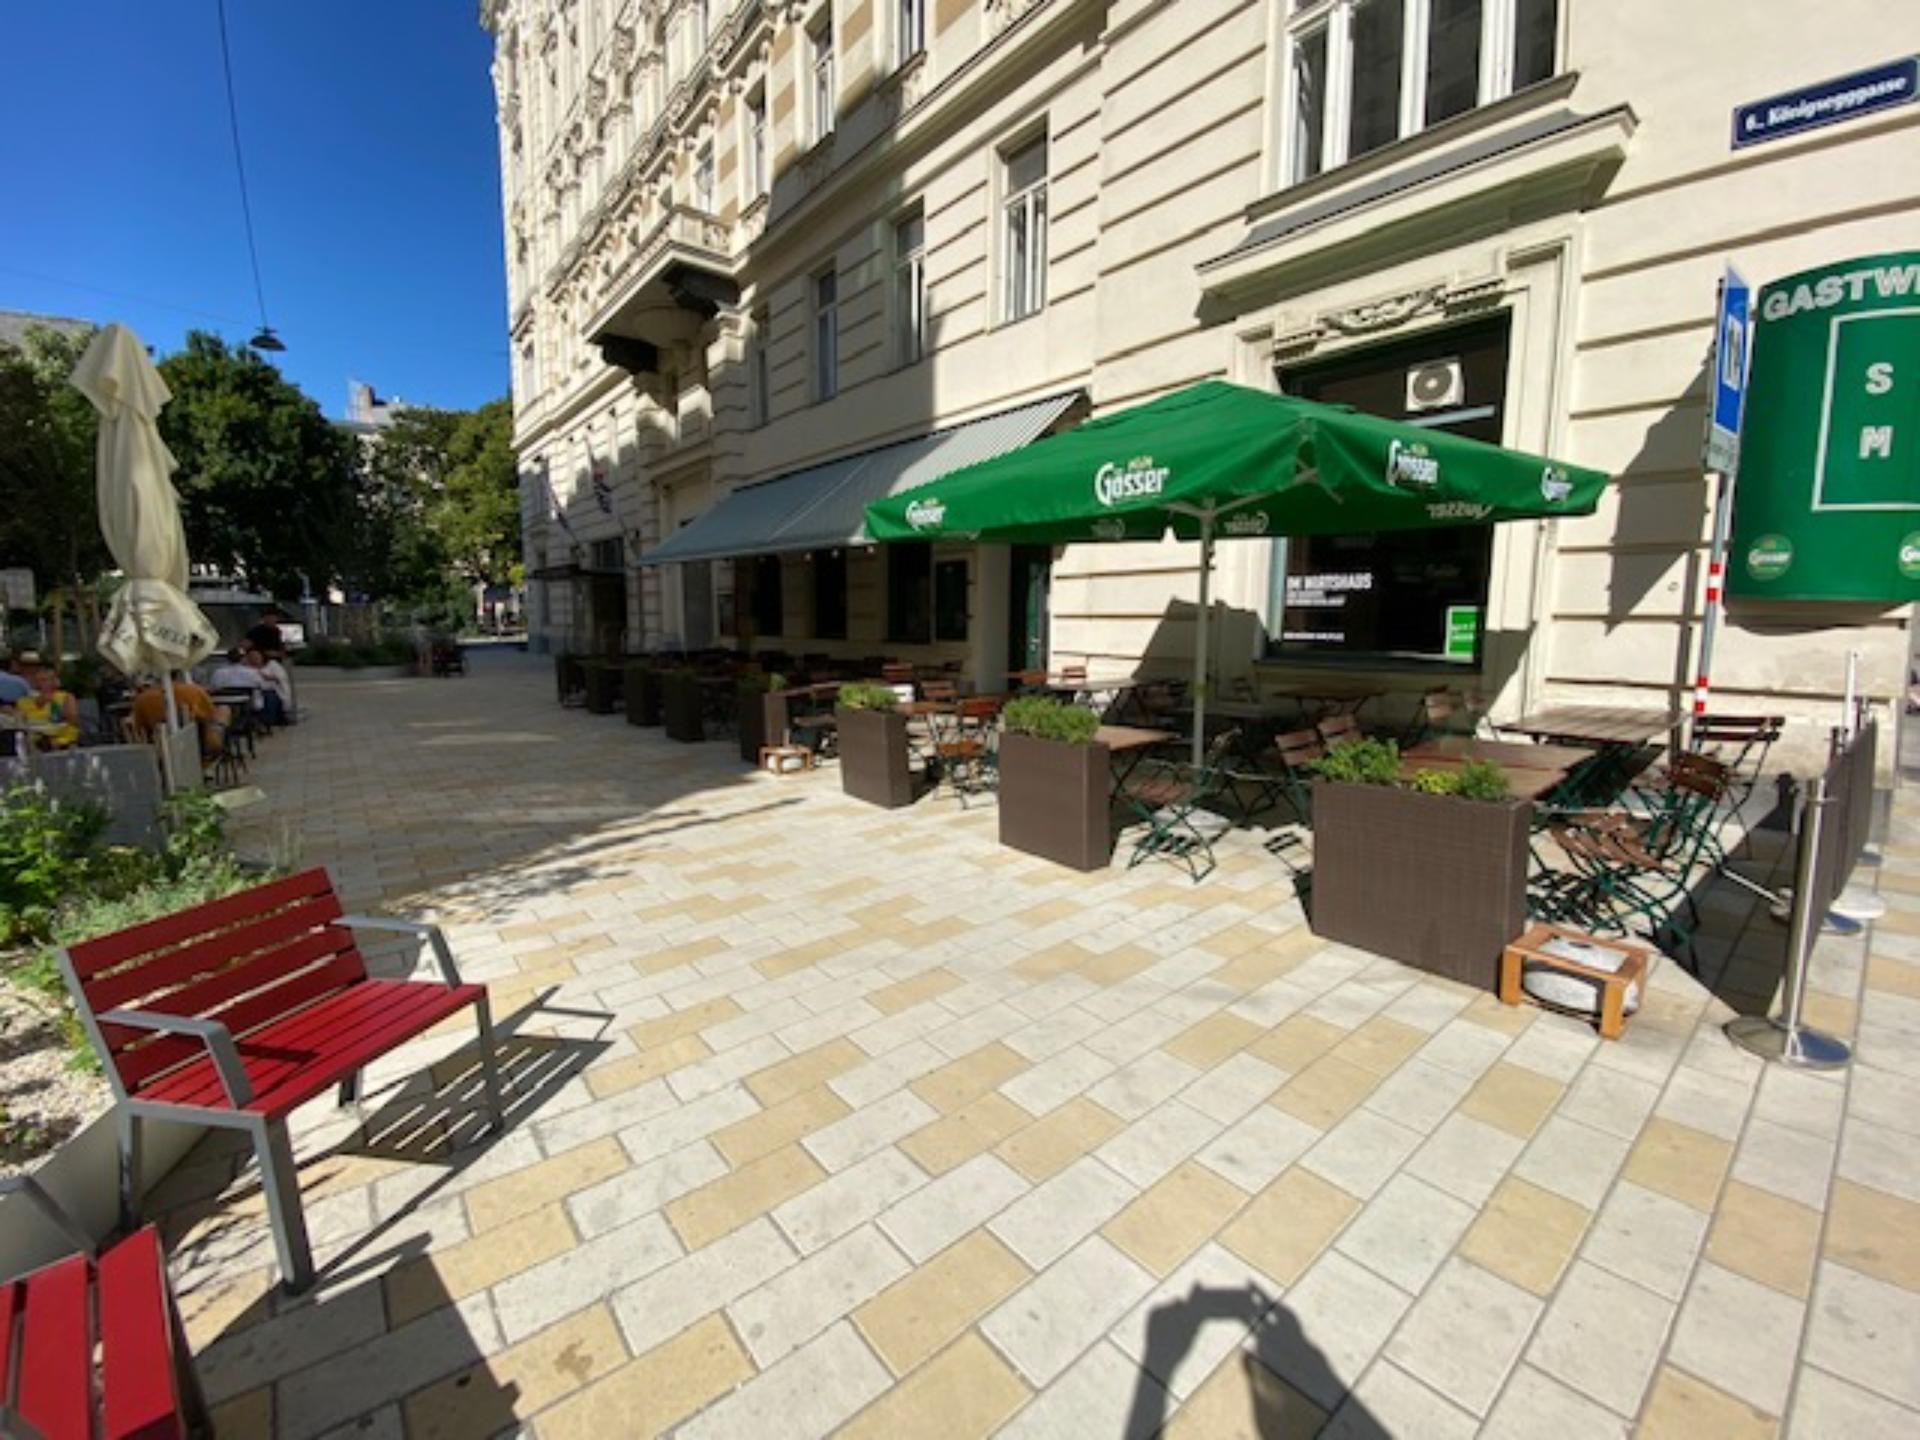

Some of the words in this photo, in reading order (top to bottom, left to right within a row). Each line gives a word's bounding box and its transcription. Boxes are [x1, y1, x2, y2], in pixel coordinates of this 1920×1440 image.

[1865, 362, 1894, 394] S
[1859, 425, 1893, 459] M
[1095, 462, 1170, 506] Gösser
